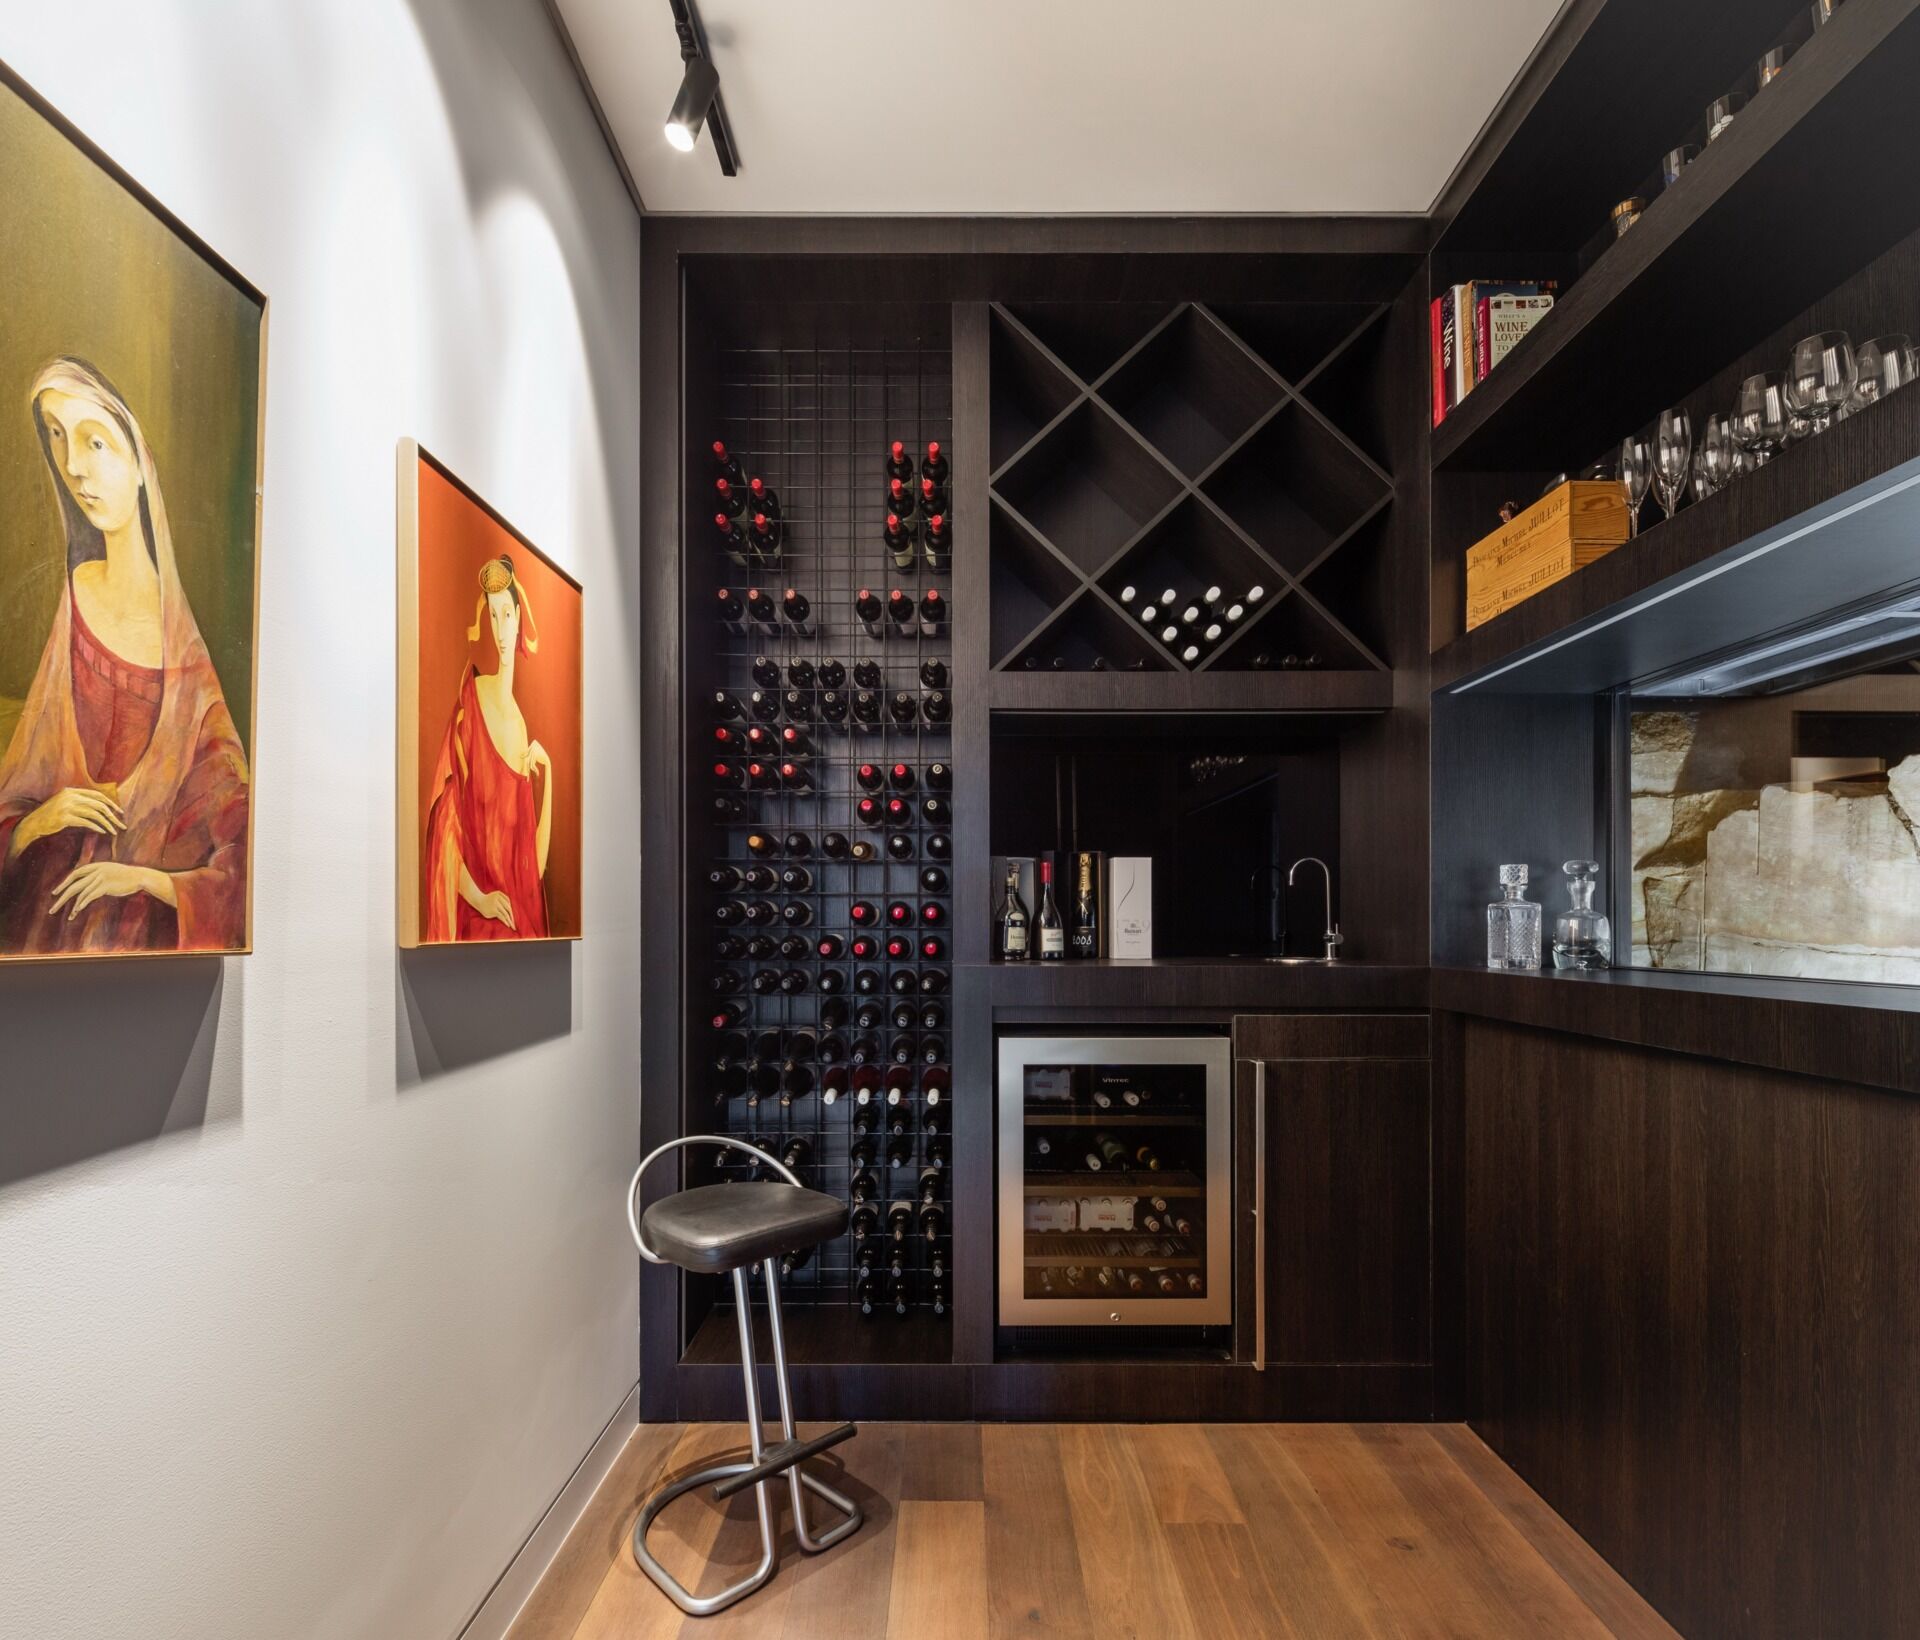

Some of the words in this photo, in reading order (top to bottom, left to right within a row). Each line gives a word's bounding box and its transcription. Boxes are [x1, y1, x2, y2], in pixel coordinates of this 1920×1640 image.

[1495, 322, 1528, 332] WINE
[1495, 332, 1525, 342] LOVE
[1443, 320, 1454, 370] Wine
